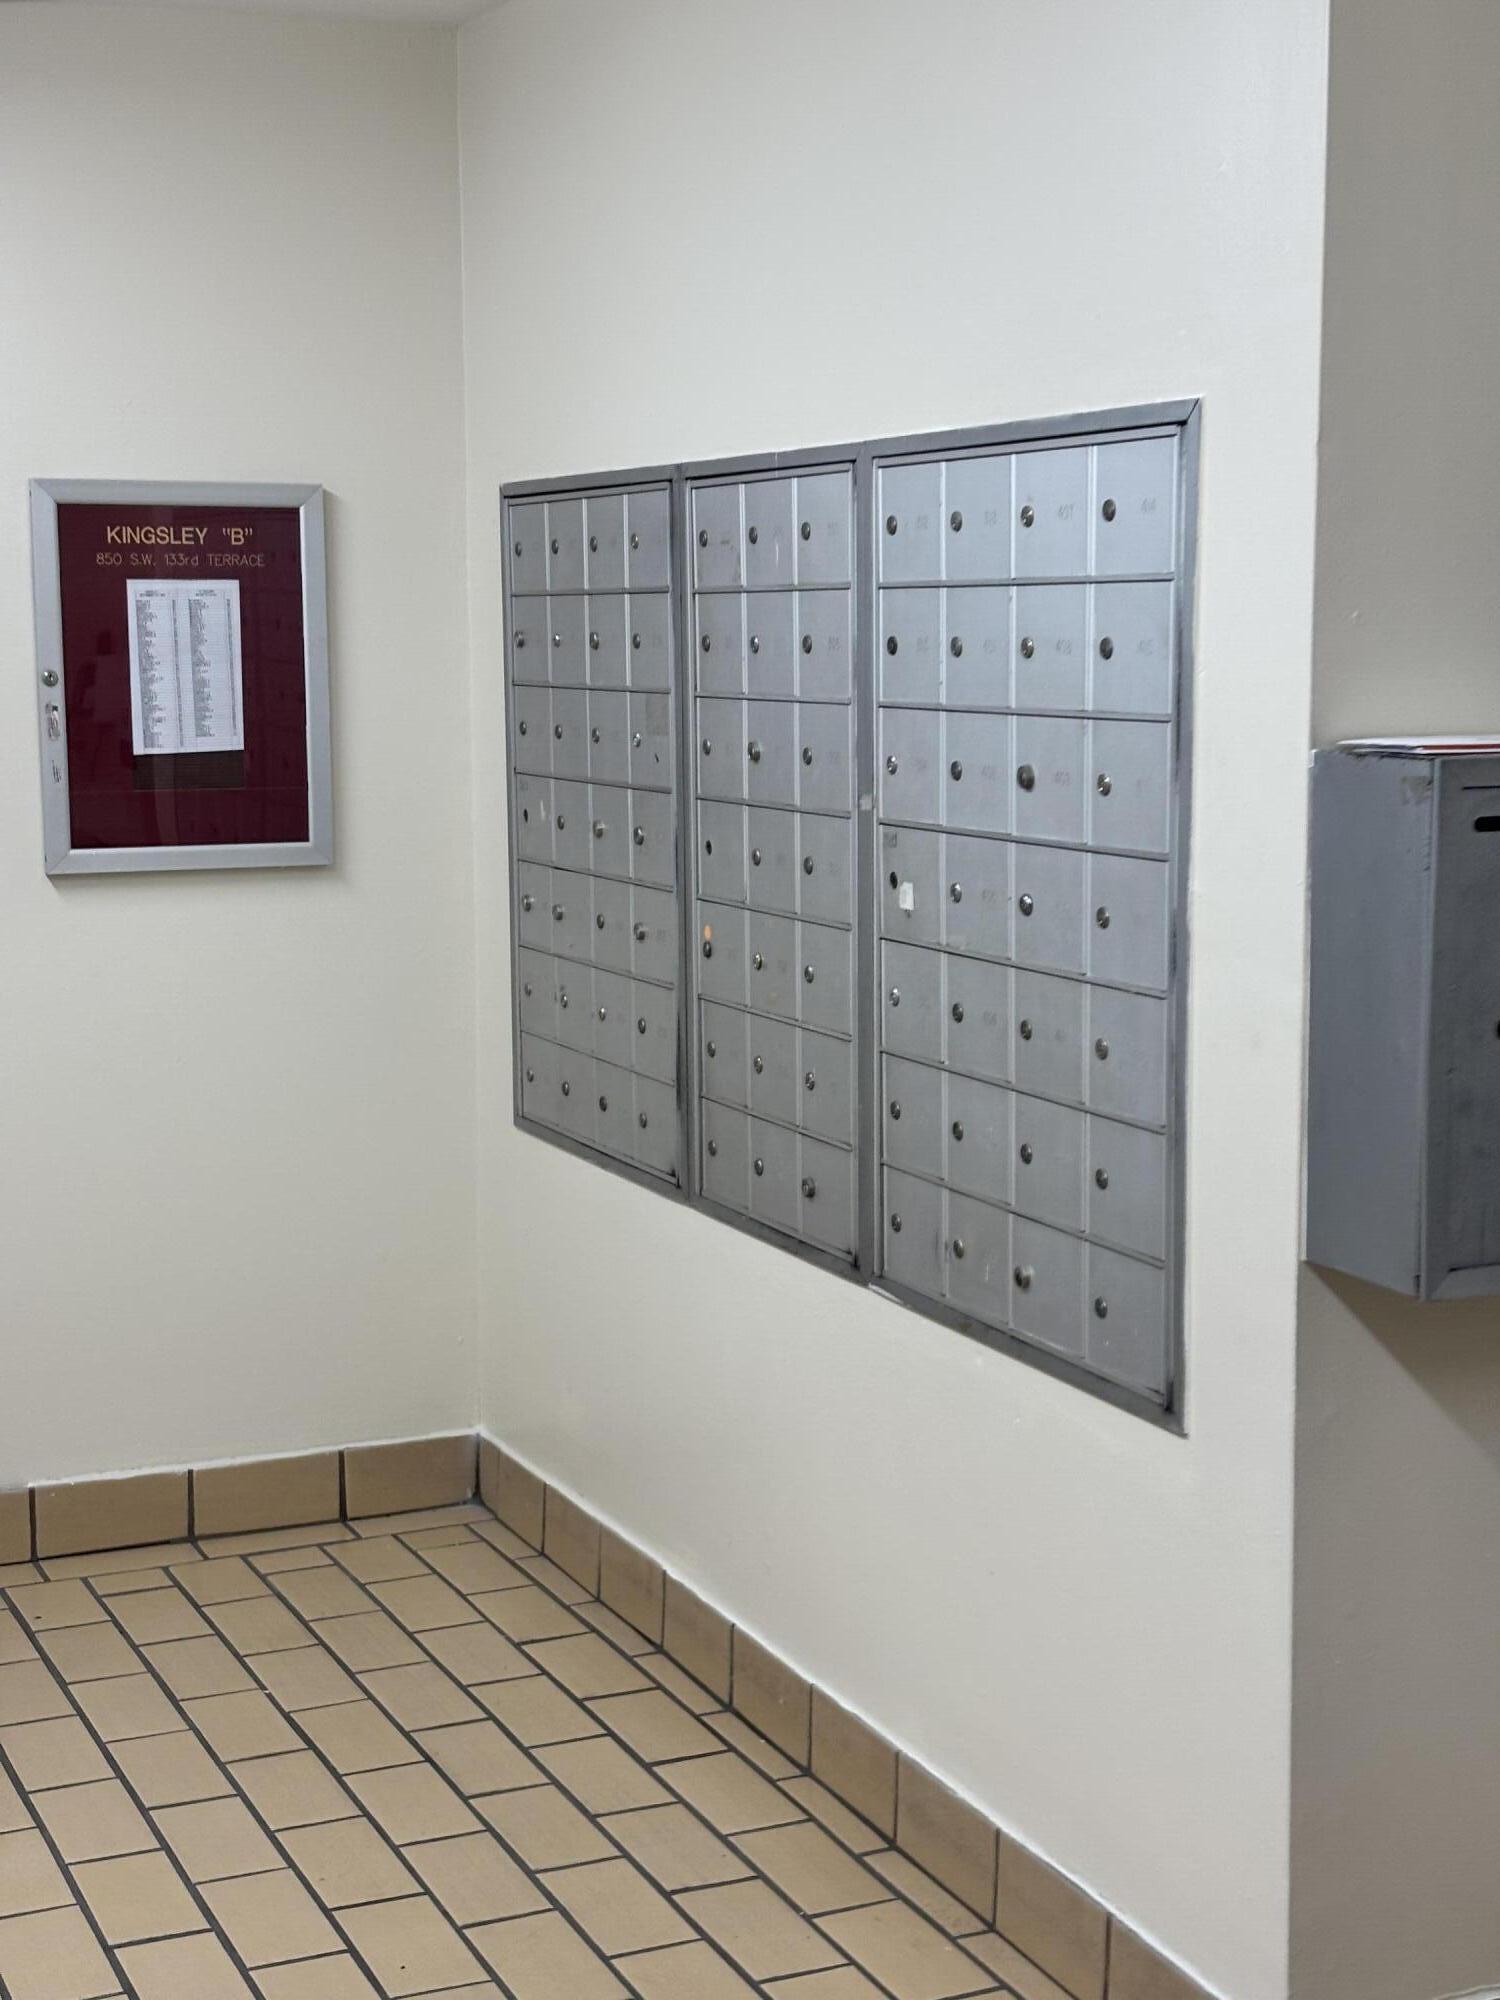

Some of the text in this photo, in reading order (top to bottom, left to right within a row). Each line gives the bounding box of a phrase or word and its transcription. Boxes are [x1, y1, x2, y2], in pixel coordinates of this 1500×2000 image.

[106, 525, 253, 546] KINGSLEY "B"
[96, 552, 123, 567] 850
[164, 552, 199, 567] 133rd
[207, 553, 265, 568] TERRACE
